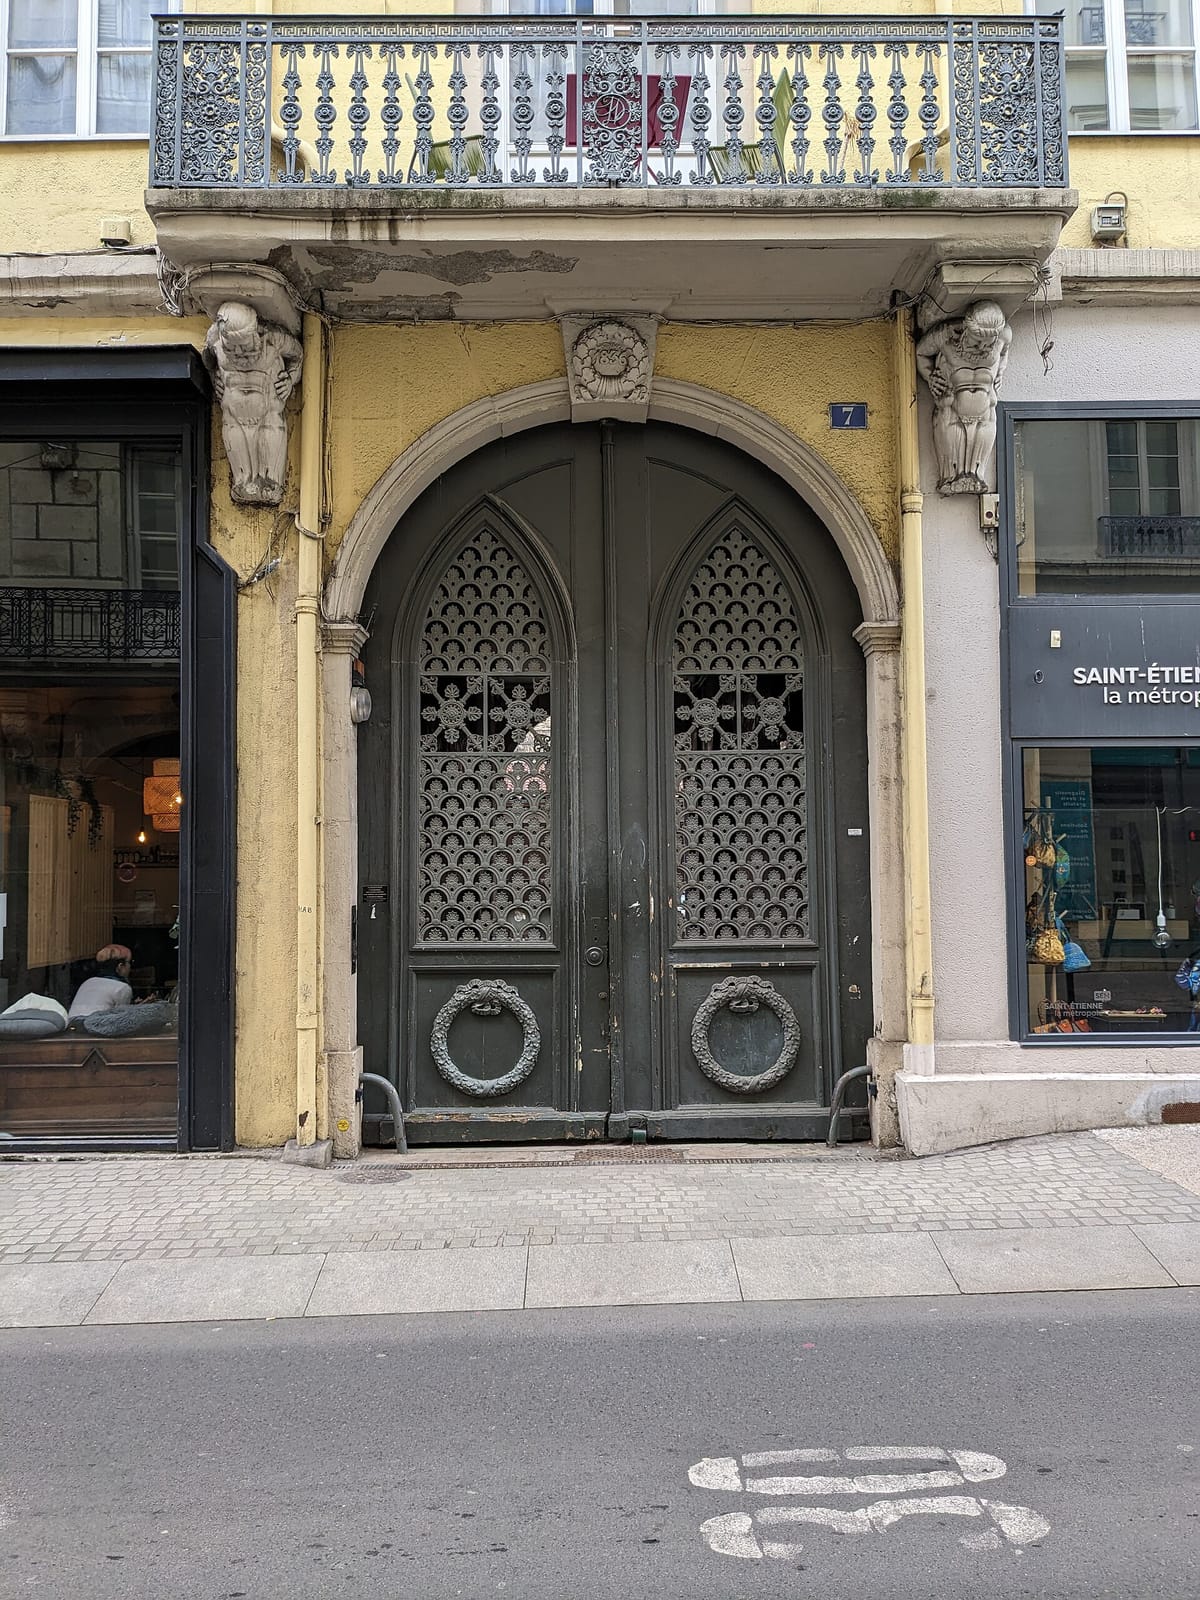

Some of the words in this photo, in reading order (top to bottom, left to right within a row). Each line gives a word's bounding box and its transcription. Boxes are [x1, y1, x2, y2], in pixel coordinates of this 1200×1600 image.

[842, 407, 854, 426] 7
[1103, 686, 1122, 704] la
[1044, 1001, 1104, 1010] SAINT-ÉTIENNE
